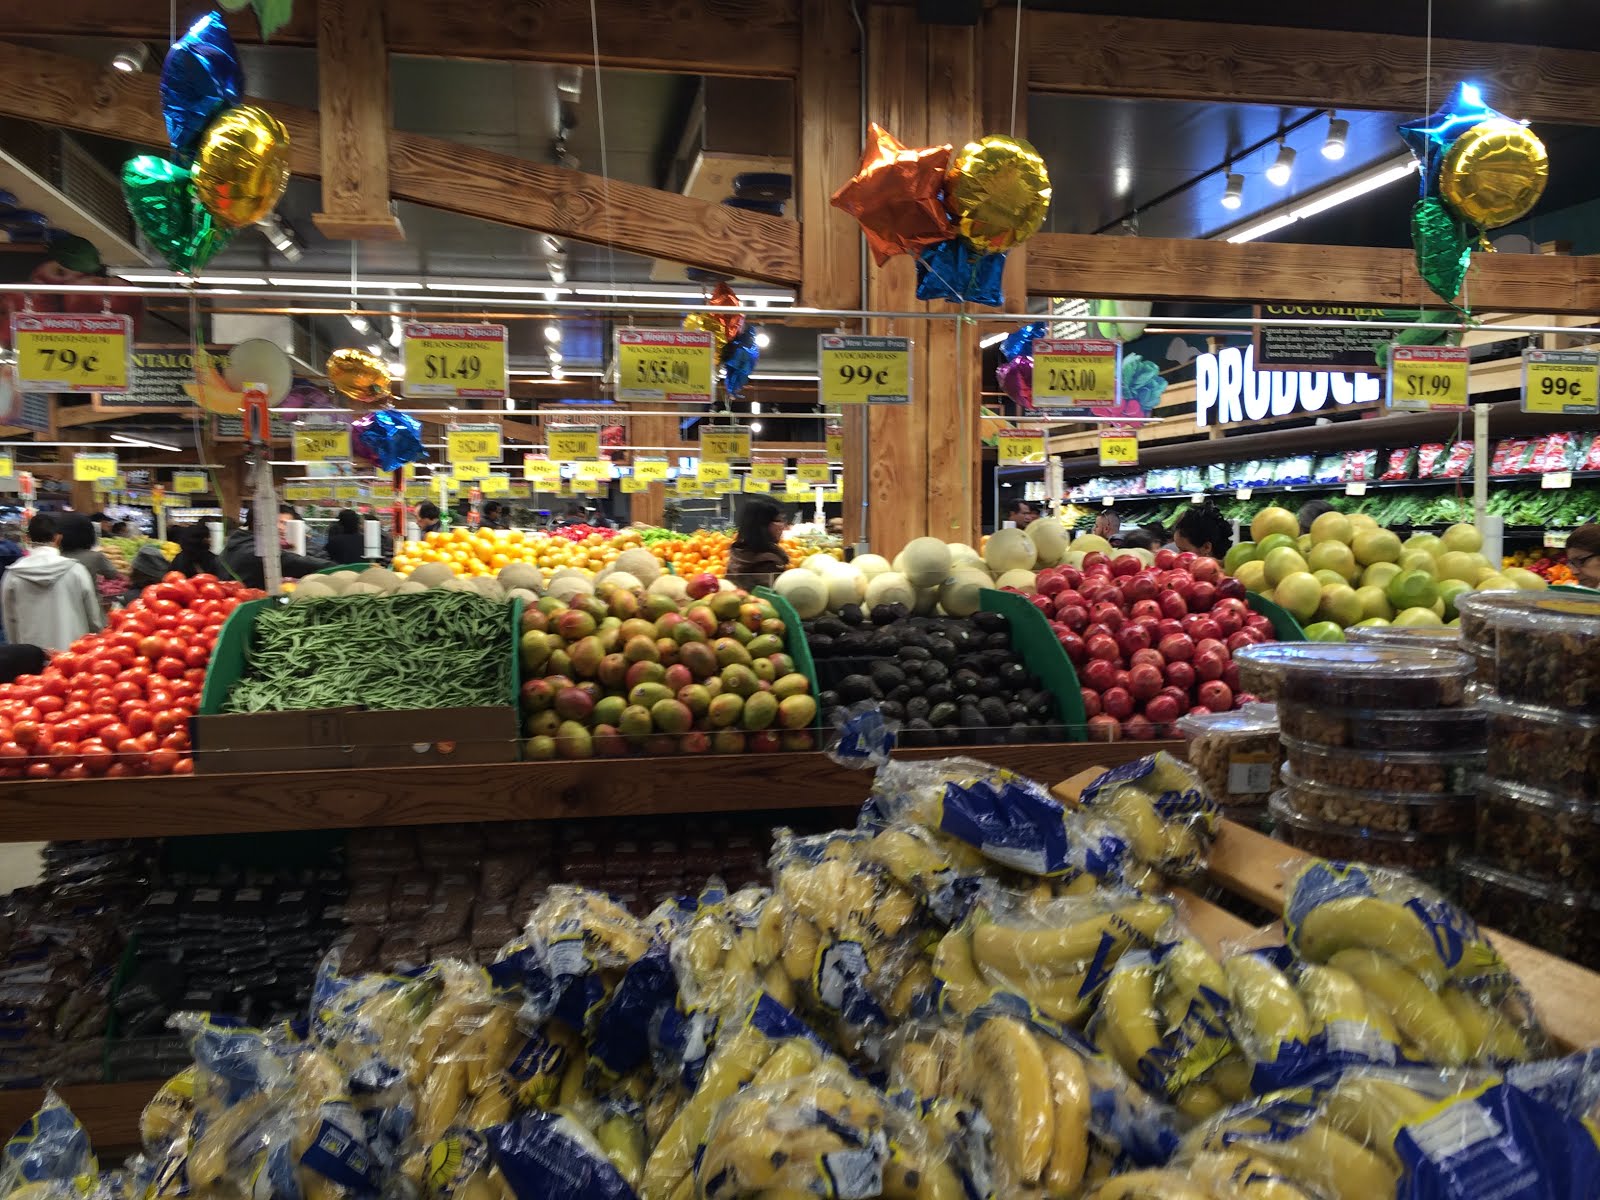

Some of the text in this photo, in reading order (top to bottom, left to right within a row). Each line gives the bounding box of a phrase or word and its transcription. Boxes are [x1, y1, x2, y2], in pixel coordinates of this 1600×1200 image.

[43, 318, 121, 332] Weekly Special
[430, 326, 503, 338] Weekly Special
[642, 332, 709, 345] Weekly Special
[845, 339, 906, 348] New Lower Price
[1053, 343, 1113, 353] Weekly Special
[1412, 349, 1467, 360] Weekly Special
[38, 348, 101, 377] 79¢
[424, 353, 481, 380] $1.49
[839, 365, 889, 389] 99¢
[1048, 369, 1096, 391] 2/$3.00
[1407, 374, 1451, 396] $1.99
[1541, 377, 1582, 400] 99¢
[1107, 445, 1128, 456] 49¢
